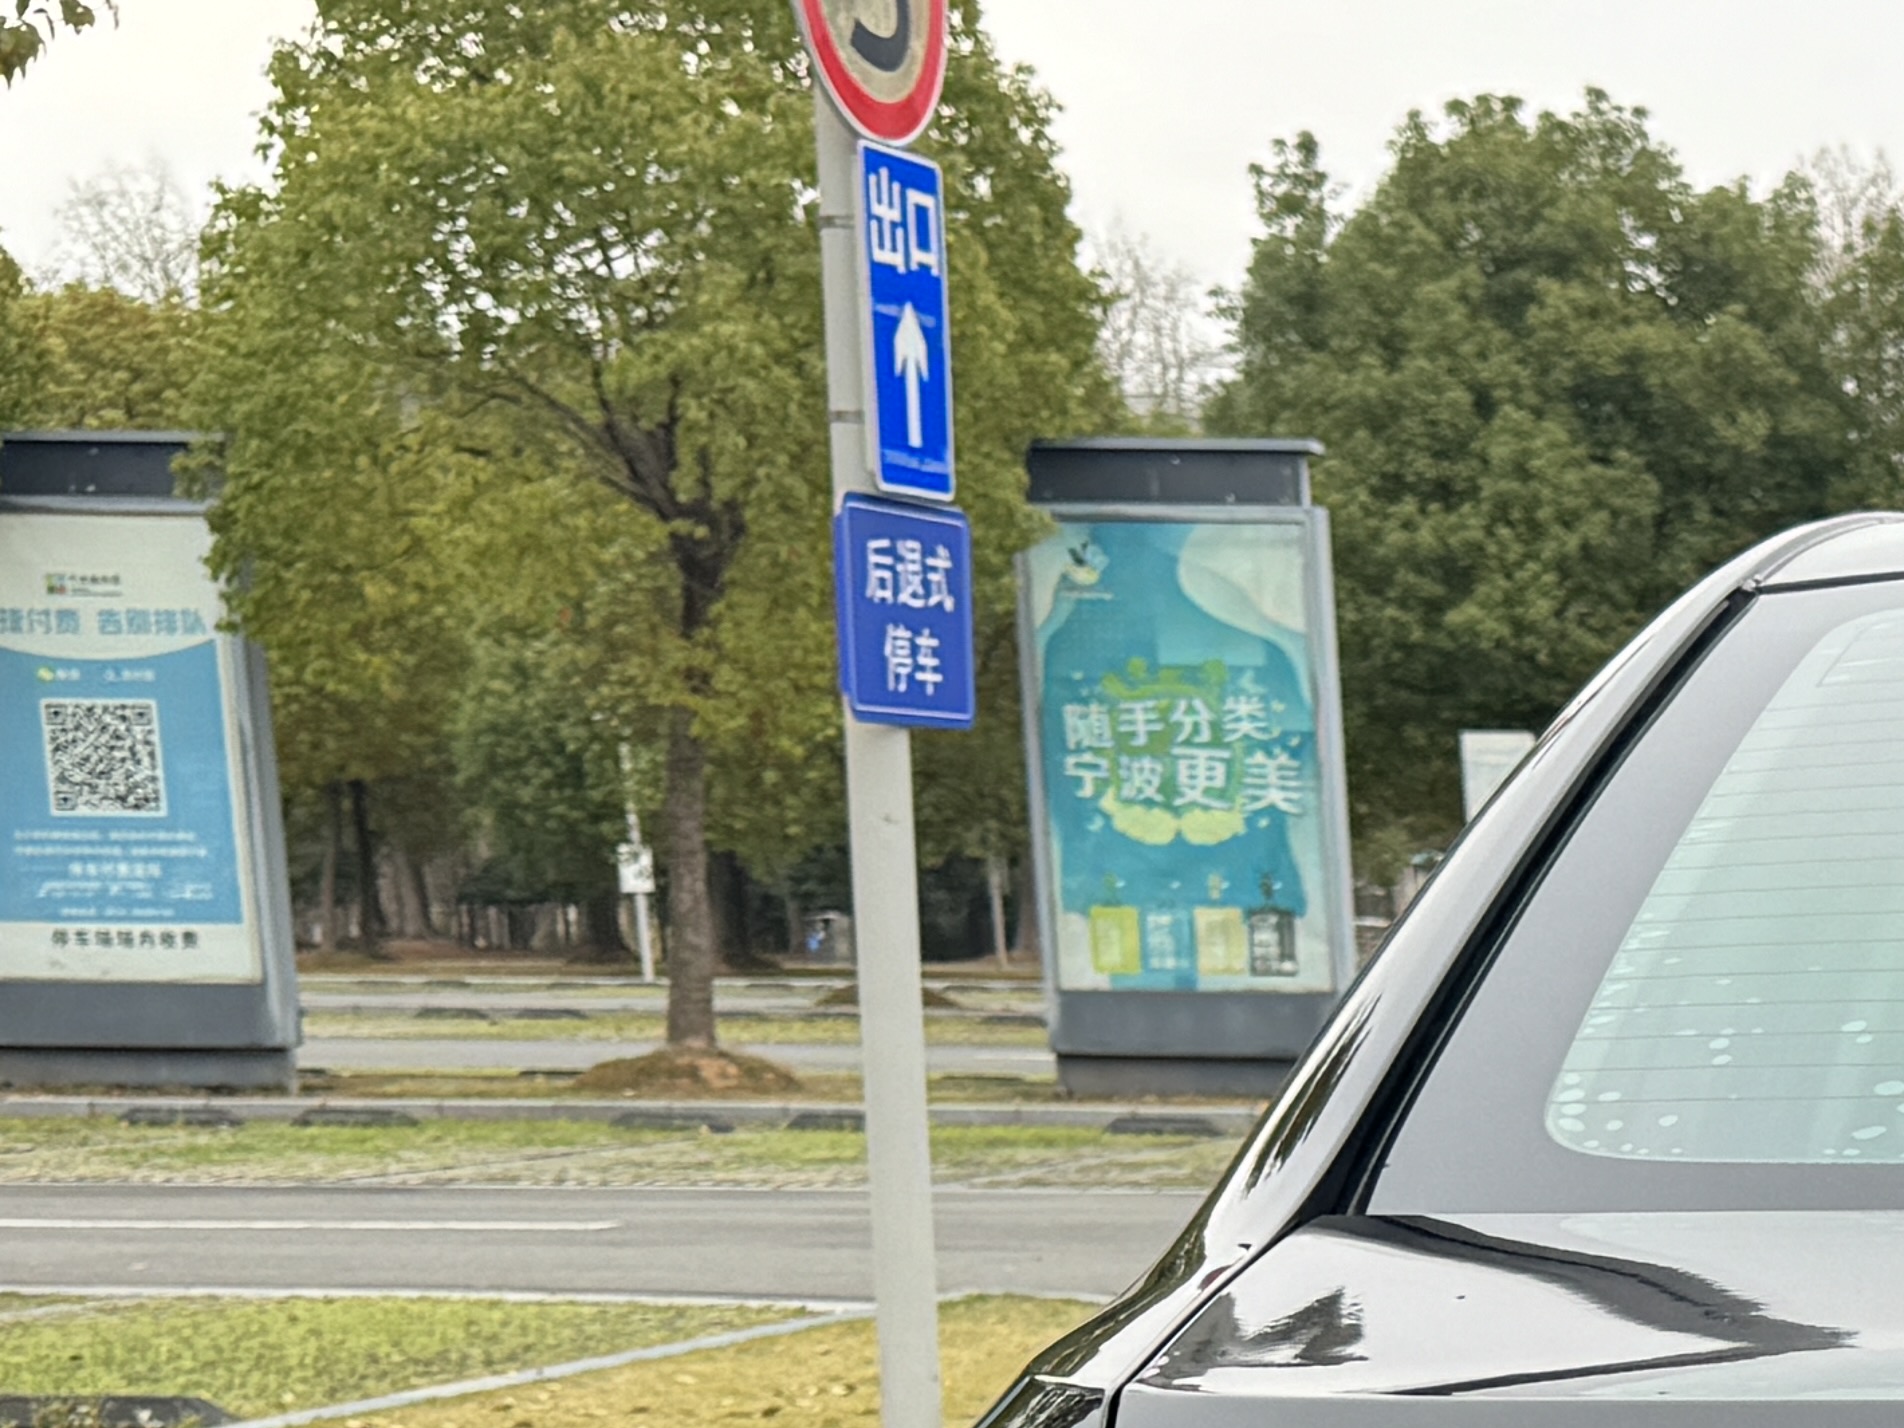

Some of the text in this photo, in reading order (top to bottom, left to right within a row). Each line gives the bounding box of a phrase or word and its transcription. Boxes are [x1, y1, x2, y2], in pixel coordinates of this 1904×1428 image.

[868, 166, 941, 277] 出口
[866, 538, 955, 613] 后退式
[884, 623, 944, 696] 停车
[1063, 695, 1270, 750] 随手分类
[1064, 746, 1304, 815] 宁波更美
